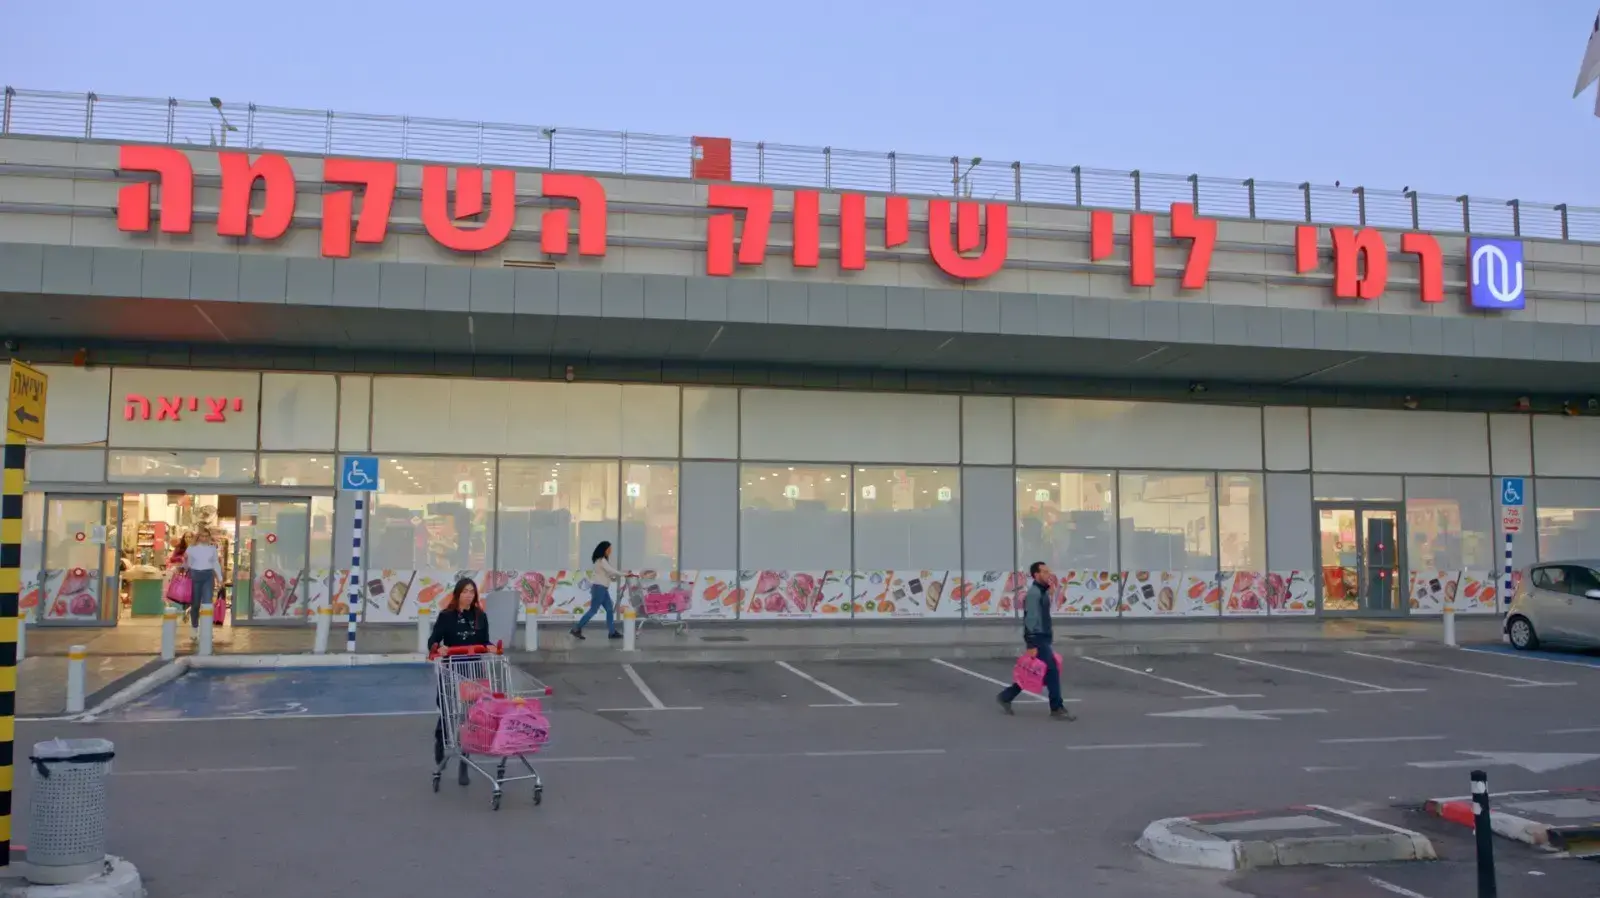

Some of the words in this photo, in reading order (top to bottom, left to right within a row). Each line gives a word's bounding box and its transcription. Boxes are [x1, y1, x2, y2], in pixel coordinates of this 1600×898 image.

[117, 145, 607, 258] השקמה
[706, 184, 1009, 279] שיווק
[1091, 204, 1217, 289] לוי
[1296, 225, 1444, 303] רמי
[12, 371, 45, 402] יציאה
[124, 394, 242, 422] יציאה
